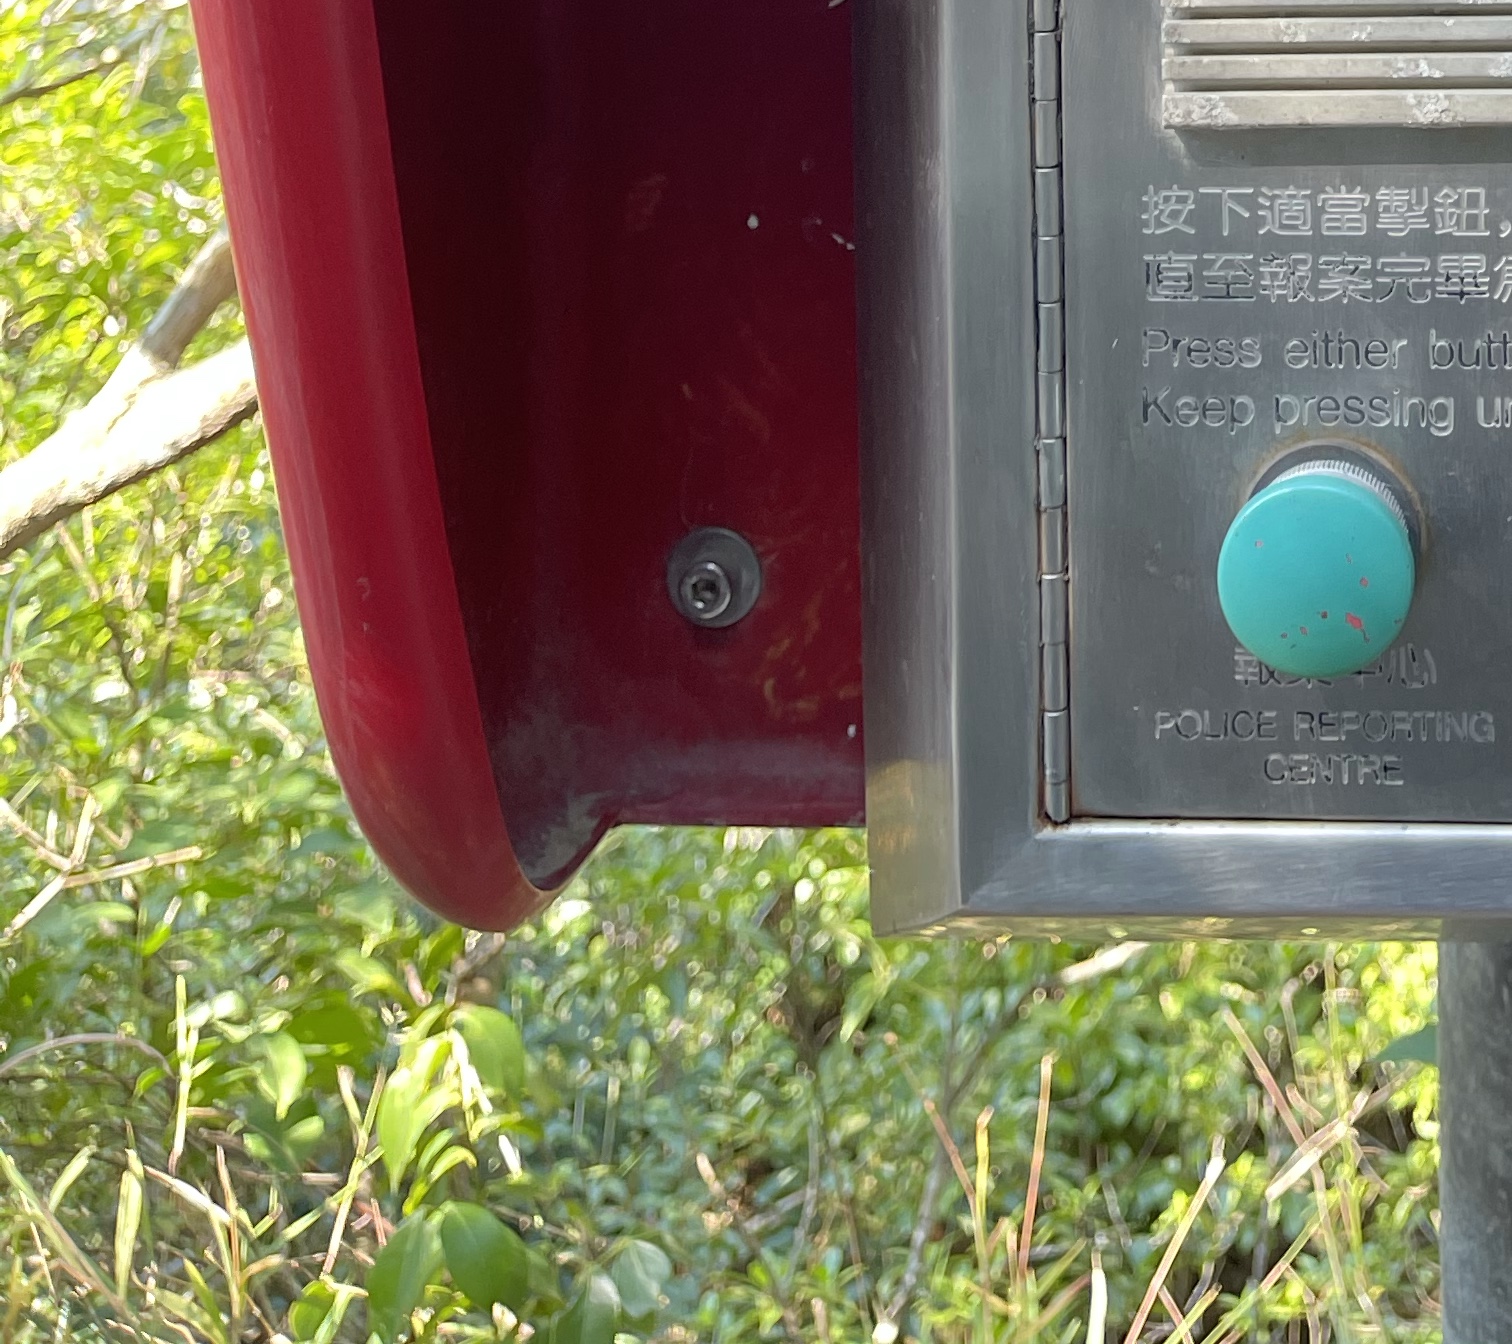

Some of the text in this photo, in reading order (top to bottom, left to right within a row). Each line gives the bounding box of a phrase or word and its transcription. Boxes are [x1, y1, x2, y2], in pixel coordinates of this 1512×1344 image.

[1142, 328, 1263, 368] Press
[1284, 329, 1408, 369] either
[1141, 386, 1255, 435] Keep
[1273, 387, 1455, 437] pressing
[1154, 709, 1495, 743] POLICE REPORTING
[1263, 753, 1404, 785] CENTRE
